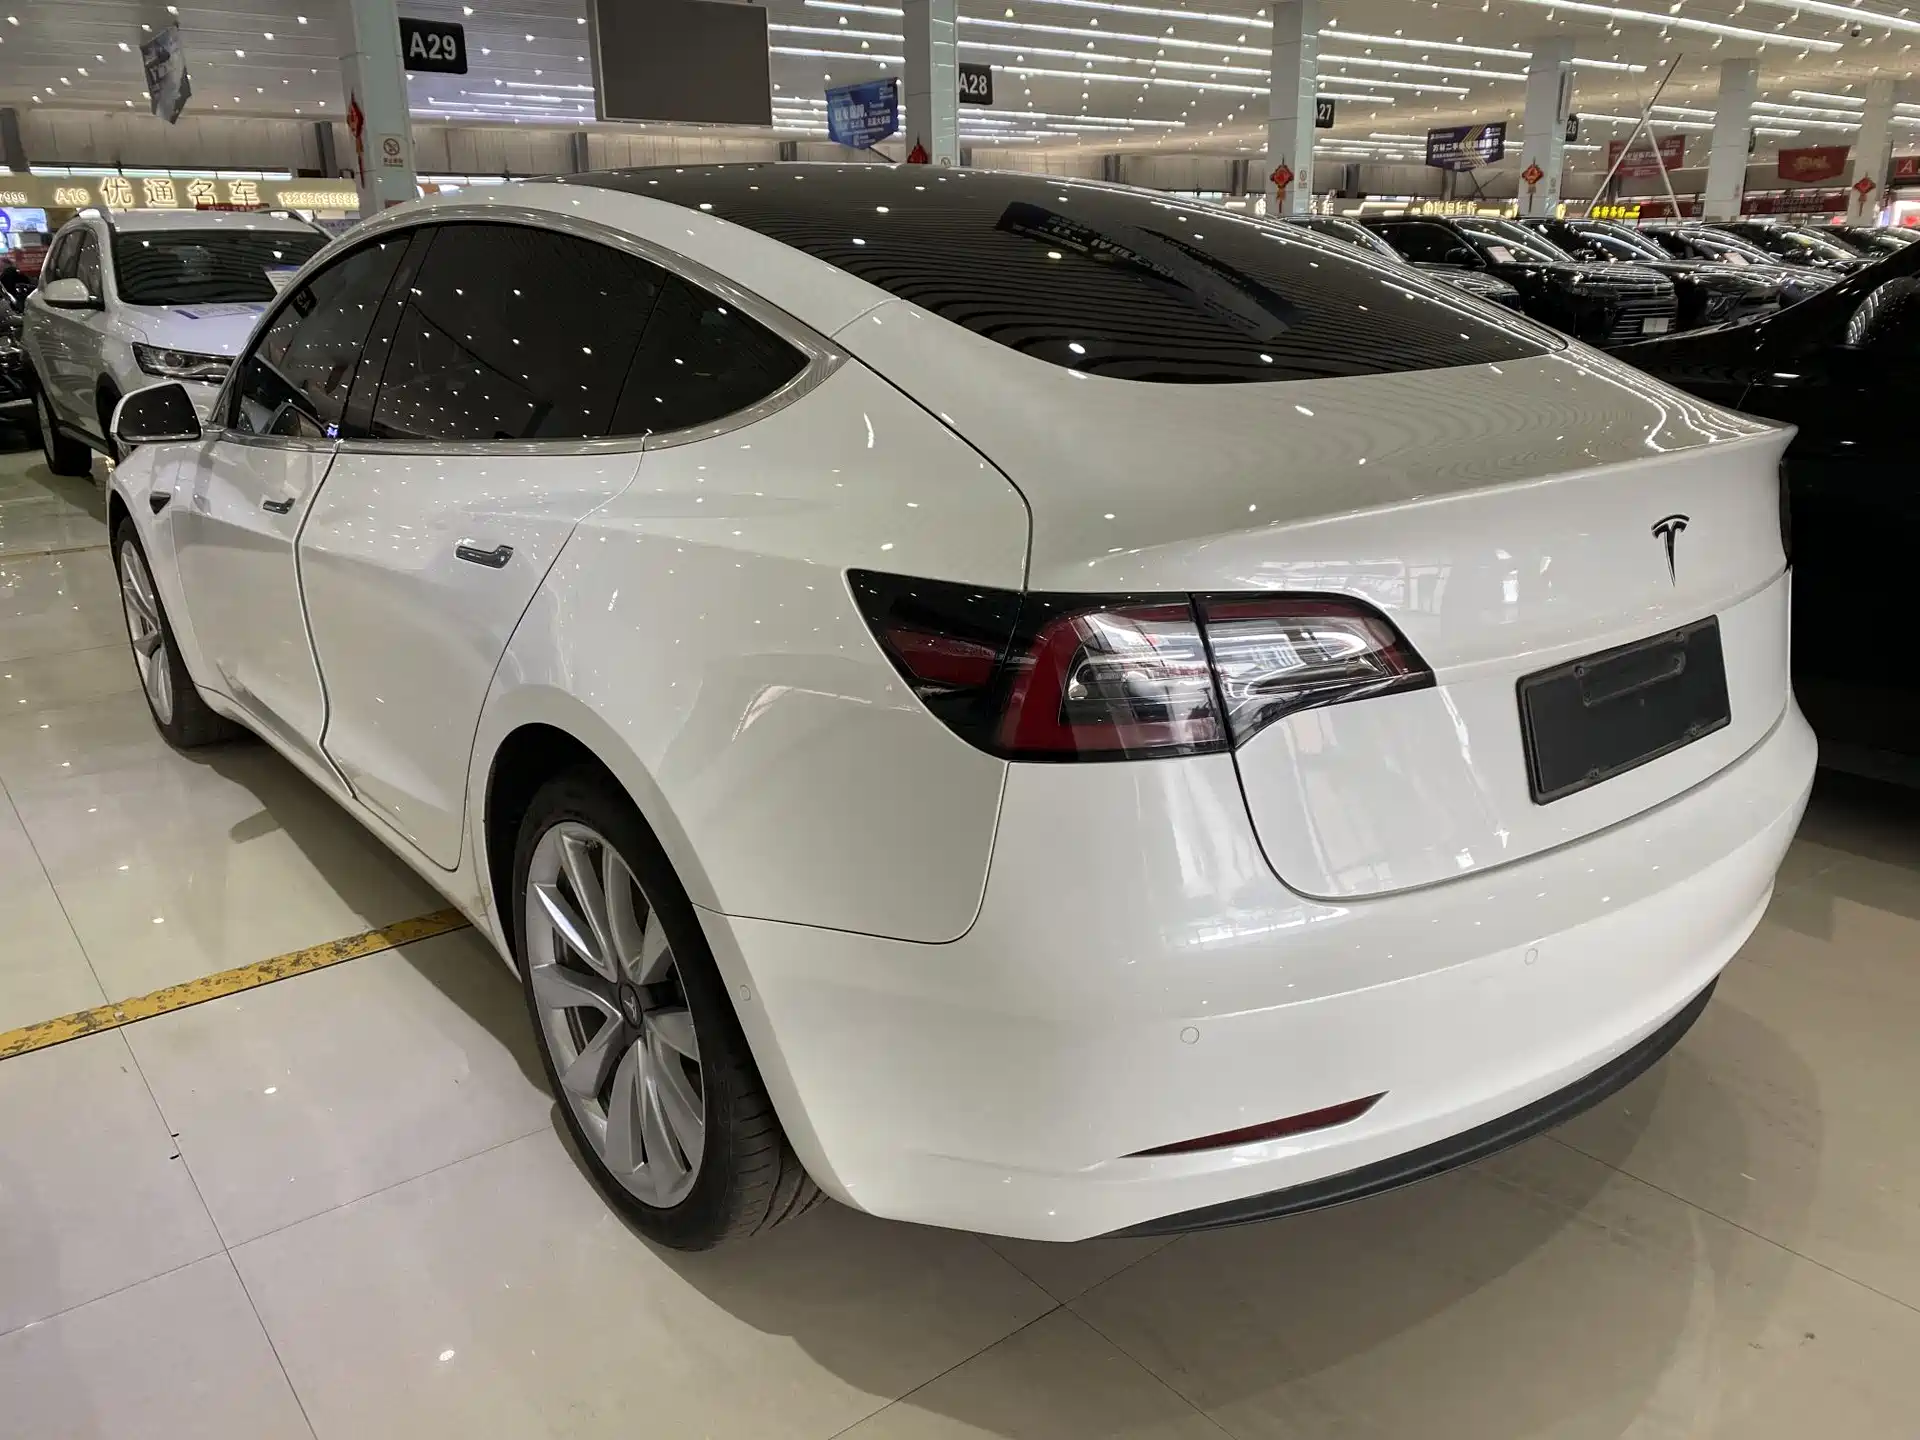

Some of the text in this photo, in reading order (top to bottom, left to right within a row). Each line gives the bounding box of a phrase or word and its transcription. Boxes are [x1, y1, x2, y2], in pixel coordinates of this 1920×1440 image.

[409, 31, 457, 61] A29
[959, 72, 988, 95] A28
[1316, 103, 1332, 120] 27
[55, 187, 90, 205] A16
[100, 175, 261, 208] 优通名车
